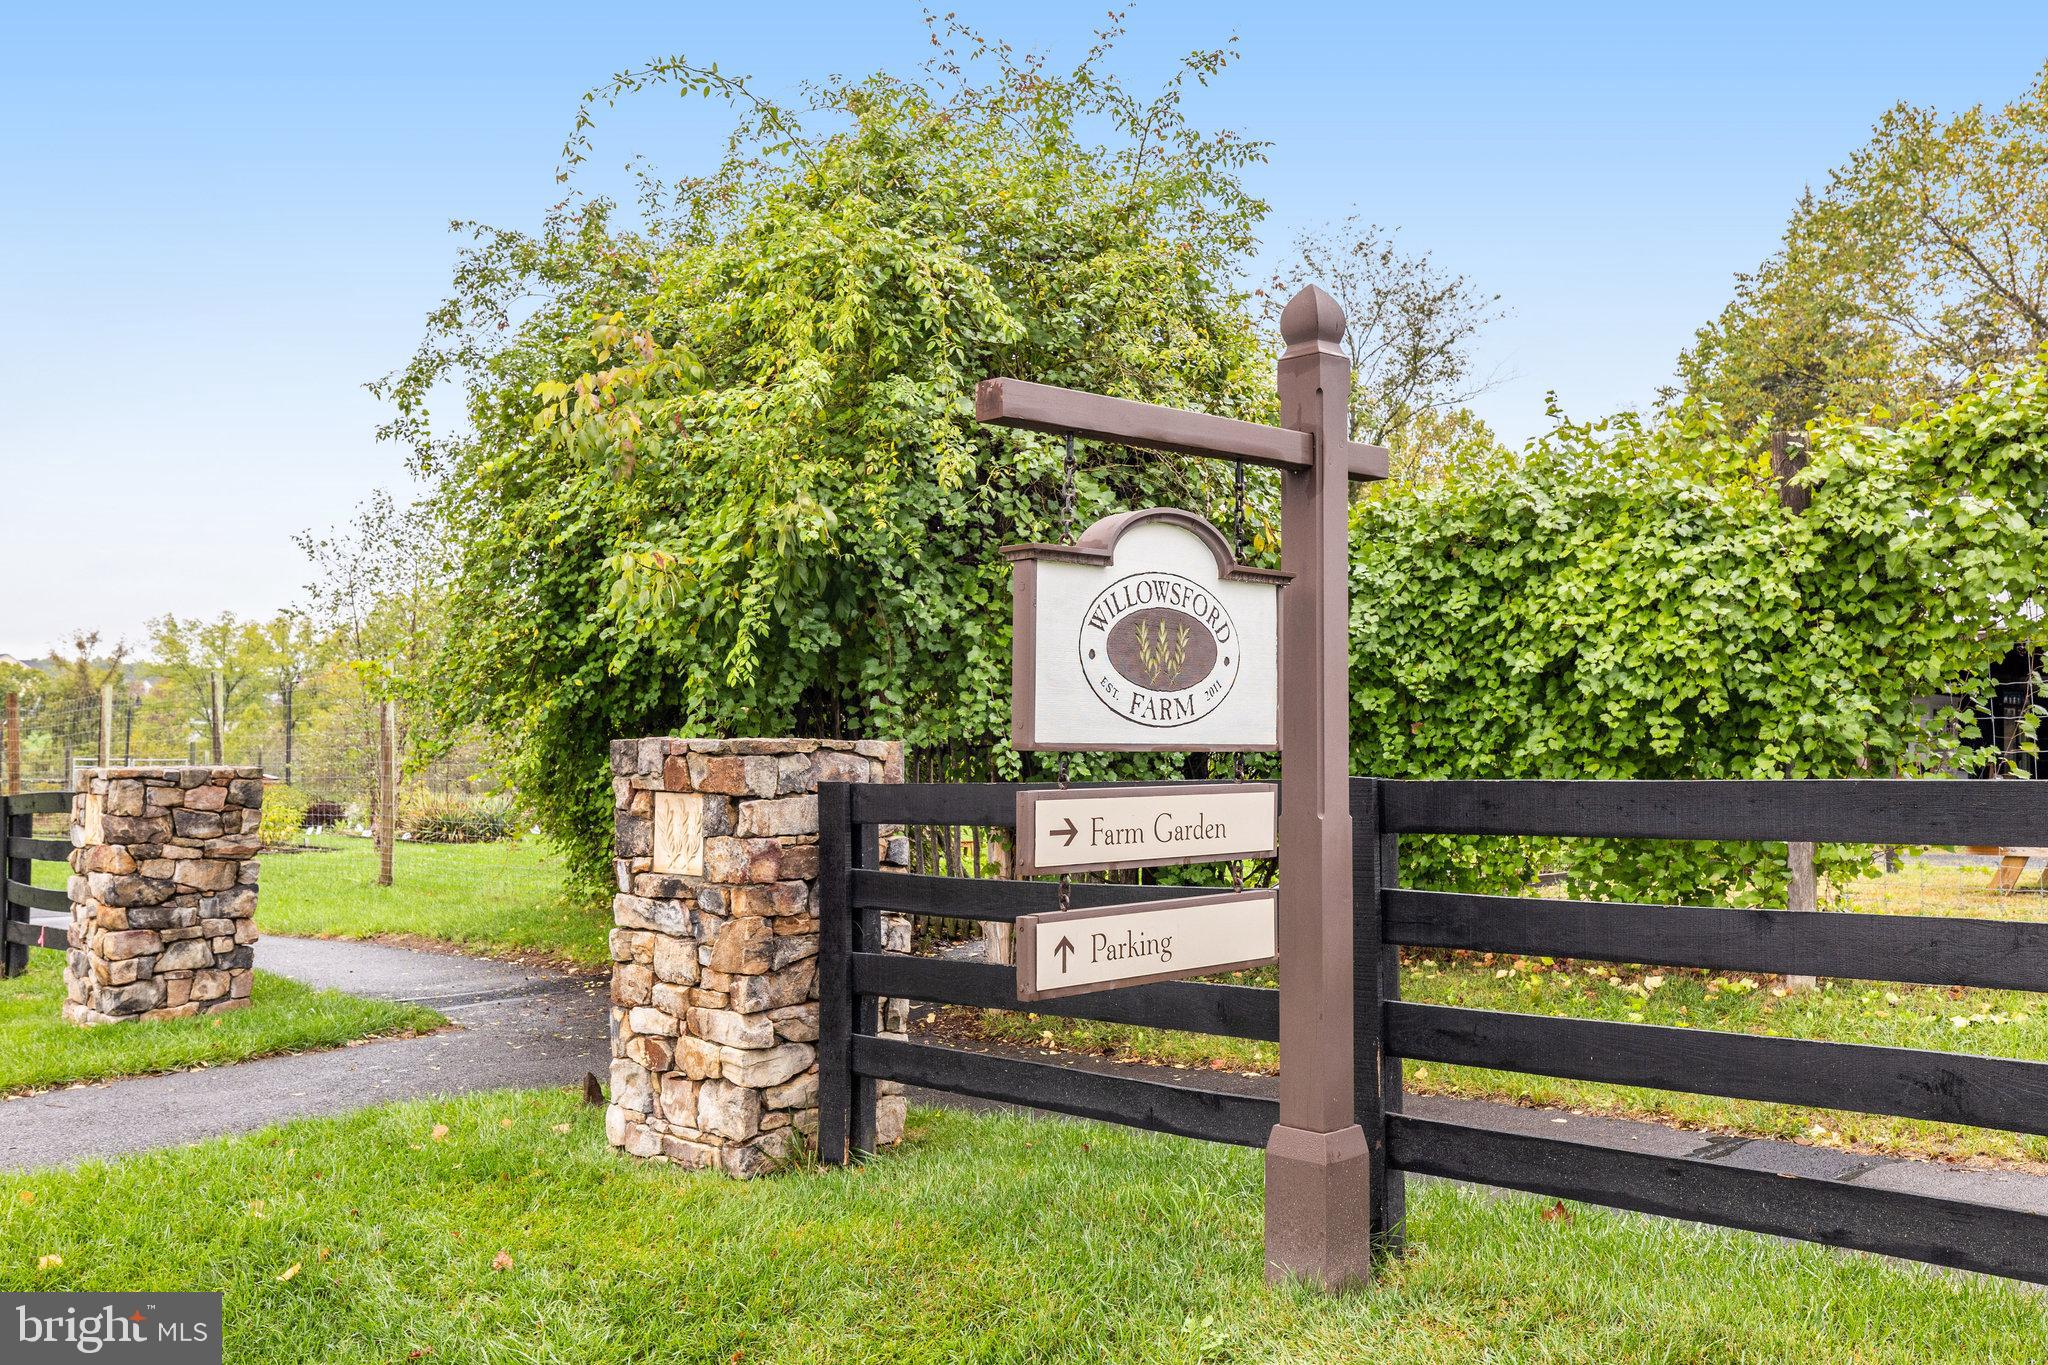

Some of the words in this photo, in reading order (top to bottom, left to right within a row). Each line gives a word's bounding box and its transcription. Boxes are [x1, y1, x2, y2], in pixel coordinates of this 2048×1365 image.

[1088, 580, 1231, 644] WILLOWSFORD
[1100, 676, 1119, 701] EST.
[1204, 680, 1223, 702] 2011
[1129, 691, 1196, 721] FARM
[1090, 816, 1144, 847] Farm
[1153, 812, 1227, 843] Garden
[1090, 930, 1173, 962] Parking
